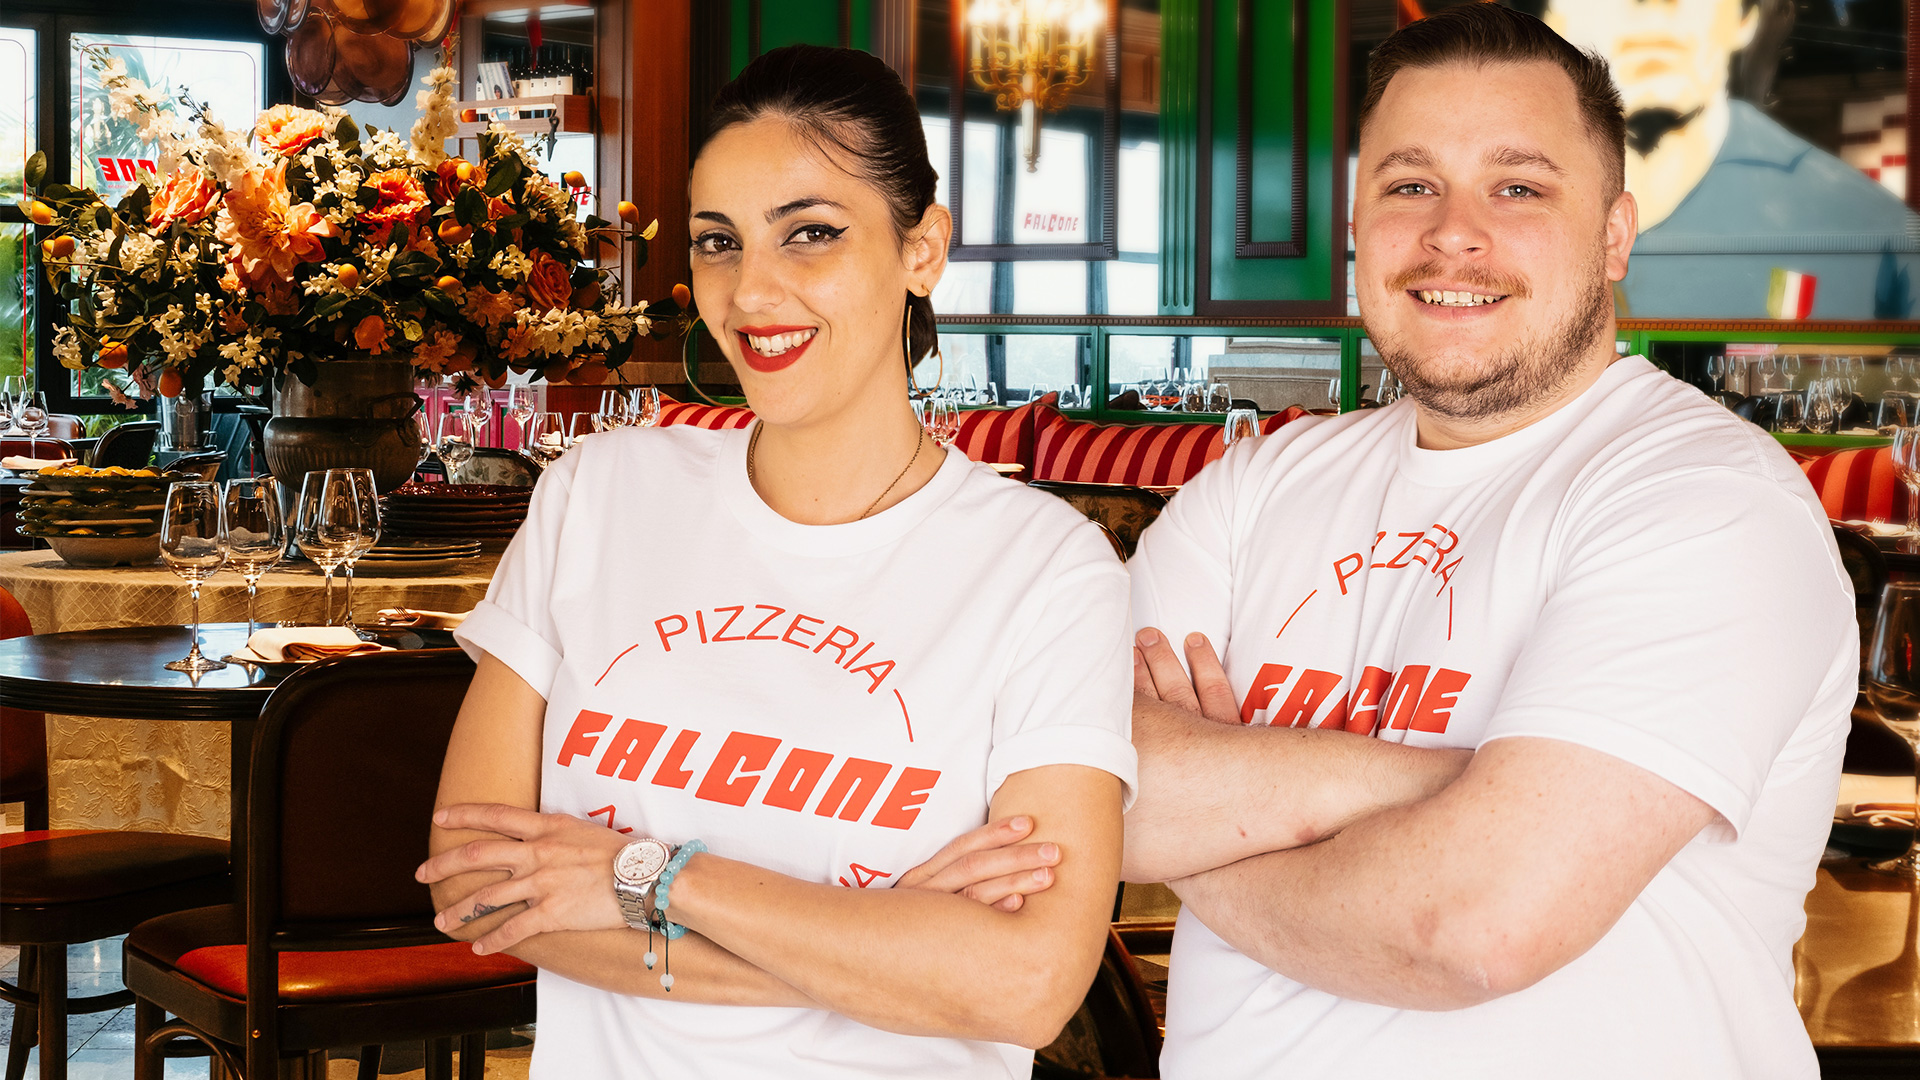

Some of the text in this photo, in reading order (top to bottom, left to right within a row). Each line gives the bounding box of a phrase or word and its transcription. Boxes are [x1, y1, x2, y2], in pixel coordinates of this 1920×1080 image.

[1023, 213, 1079, 232] FALCONE
[654, 604, 896, 695] PIZZERIA
[557, 708, 942, 830] FALCONE
